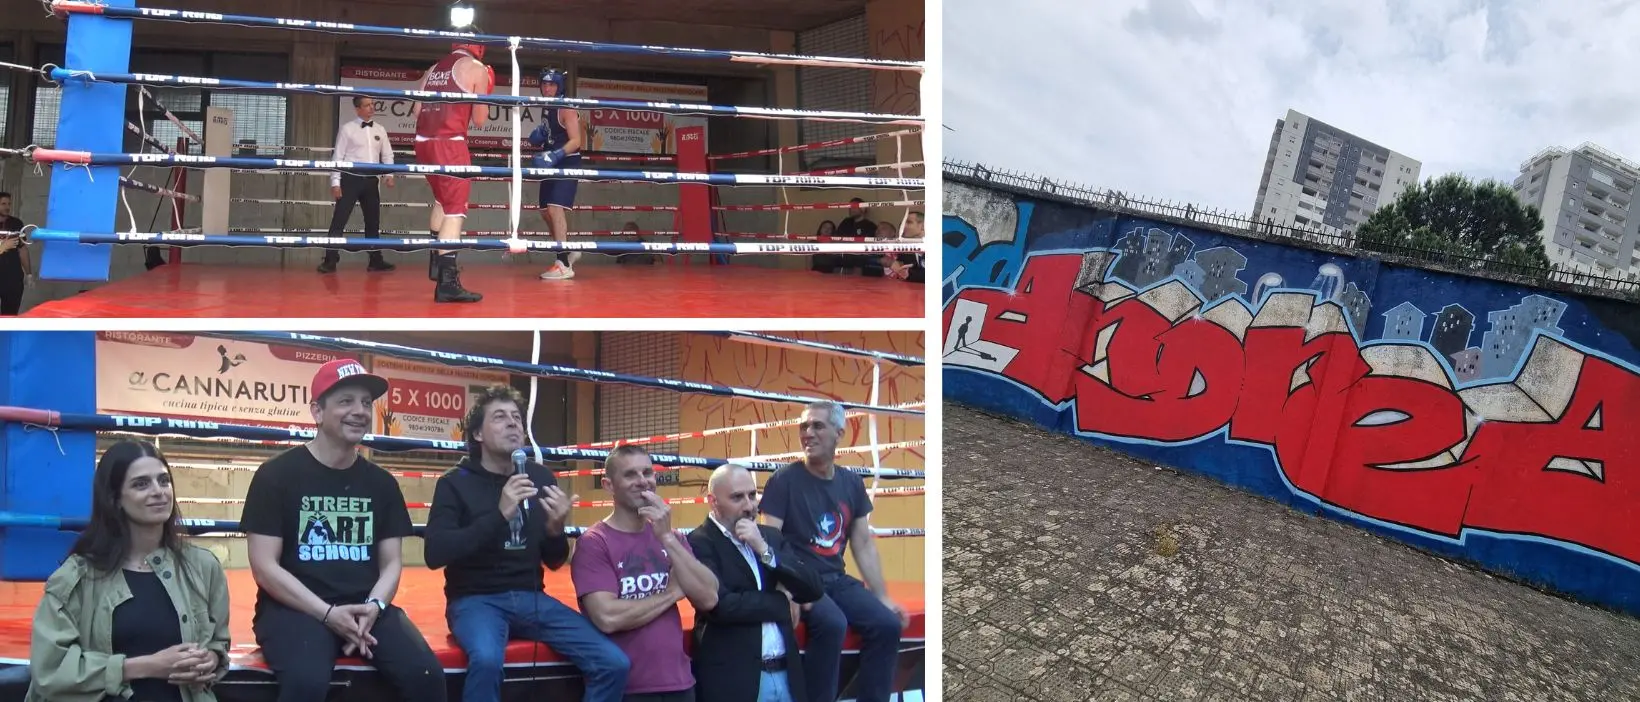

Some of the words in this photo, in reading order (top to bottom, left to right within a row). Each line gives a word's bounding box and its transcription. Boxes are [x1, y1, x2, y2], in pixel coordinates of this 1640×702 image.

[355, 69, 407, 79] RISTORANTE
[129, 153, 169, 162] TOP
[273, 159, 310, 167] TOP
[405, 164, 441, 172] TOP
[527, 167, 560, 175] TOP
[641, 171, 673, 179] TOP
[116, 232, 157, 241] TOP
[264, 236, 302, 244] TOP
[641, 242, 673, 251] TOP
[105, 330, 172, 344] RISTORANTE
[152, 372, 314, 405] CANNARUTI
[392, 387, 402, 405] 5
[407, 388, 420, 407] X
[424, 391, 463, 411] 1000
[162, 399, 197, 410] cucina
[199, 400, 228, 413] tipica
[240, 406, 266, 414] senza
[268, 405, 301, 417] glutine
[110, 415, 162, 427] TOP
[168, 418, 219, 430] RING
[402, 414, 426, 423] CODICE
[427, 417, 450, 425] FISCALE
[431, 440, 465, 449] TOP
[548, 447, 578, 456] TOP
[652, 454, 677, 462] TOP
[301, 495, 372, 511] STREET
[298, 544, 371, 561] SCHOOL
